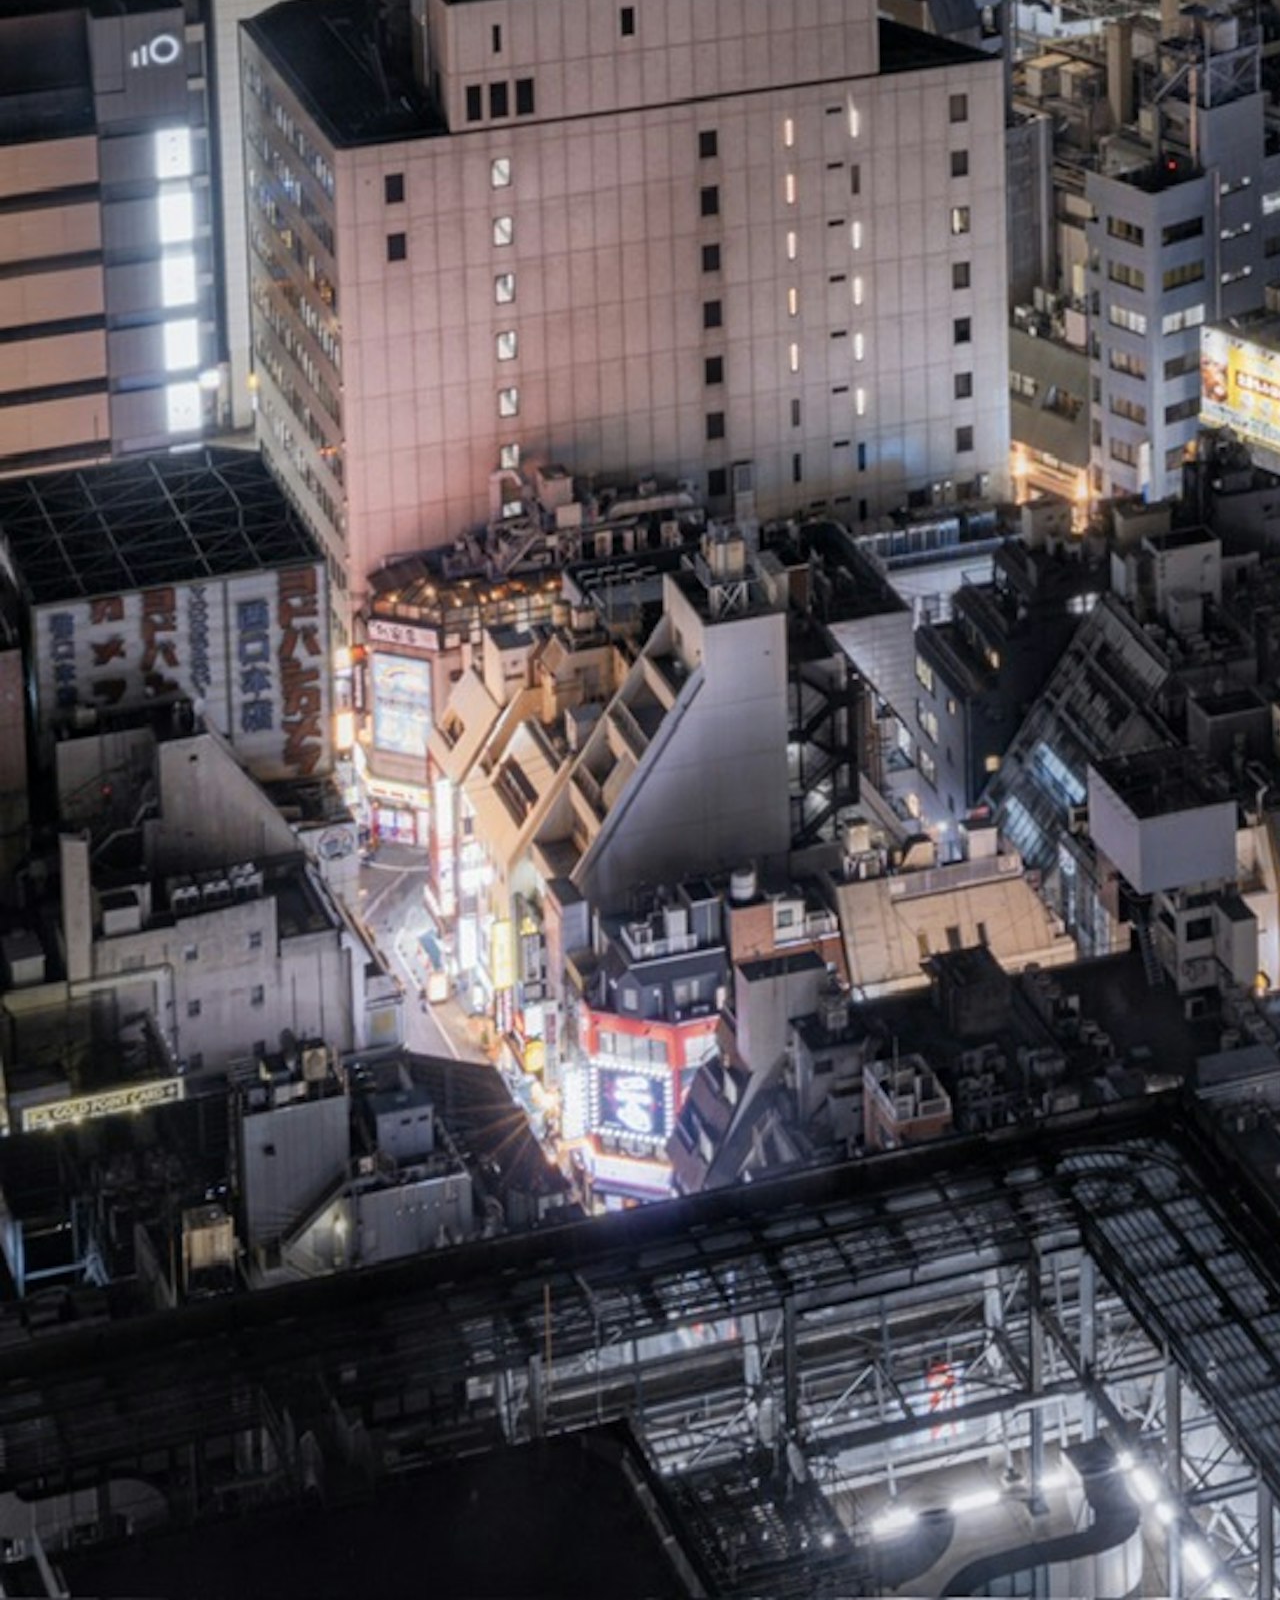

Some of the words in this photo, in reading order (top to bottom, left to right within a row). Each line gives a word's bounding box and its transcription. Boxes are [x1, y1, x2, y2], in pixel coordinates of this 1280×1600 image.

[278, 566, 322, 776] ヨドバシカメラ
[53, 1100, 90, 1121] GOLD
[127, 1087, 165, 1105] CARD
